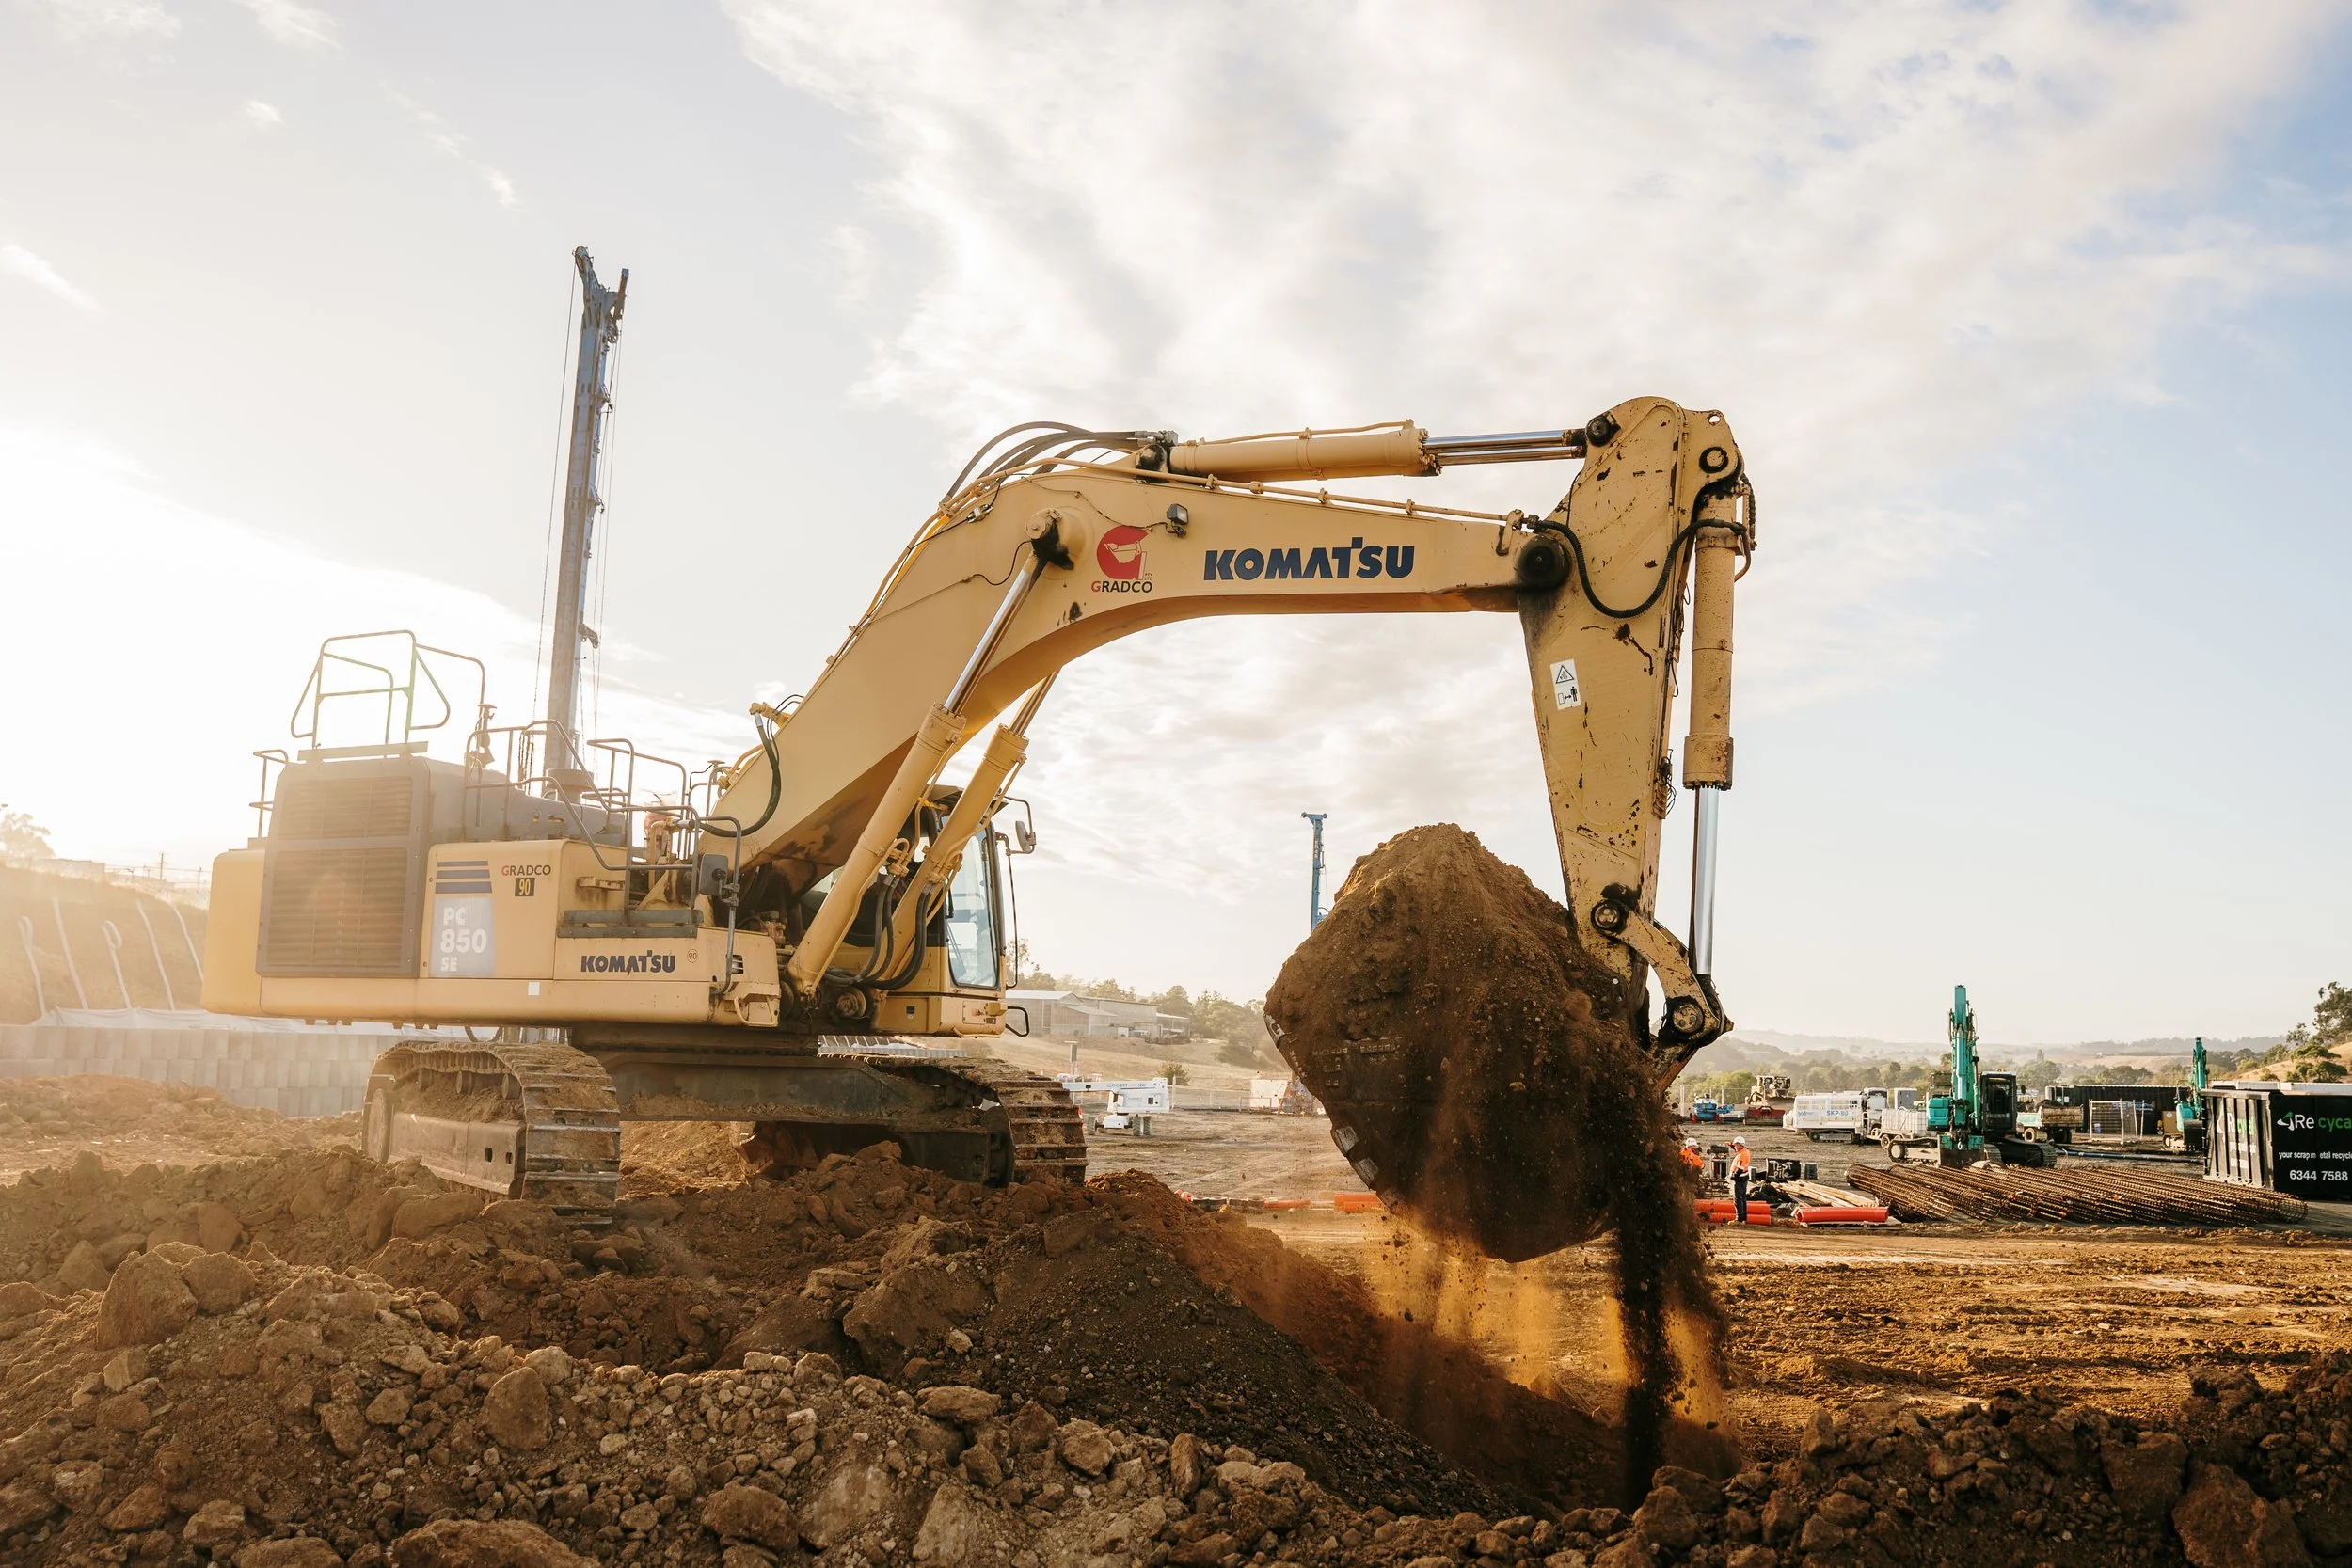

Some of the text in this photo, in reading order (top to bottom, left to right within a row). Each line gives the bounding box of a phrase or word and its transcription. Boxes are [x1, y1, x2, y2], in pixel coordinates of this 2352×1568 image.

[1204, 537, 1414, 580] KOMATSU
[1091, 580, 1152, 593] GRADCO
[501, 865, 551, 876] GRADCO
[518, 879, 531, 895] 90
[443, 907, 466, 926] PC
[440, 928, 487, 953] 850
[580, 950, 675, 974] KOMATSU
[688, 952, 697, 960] 90
[440, 957, 457, 972] SE
[1769, 1160, 1793, 1171] TEST
[2289, 1169, 2348, 1181] 6344 7588
